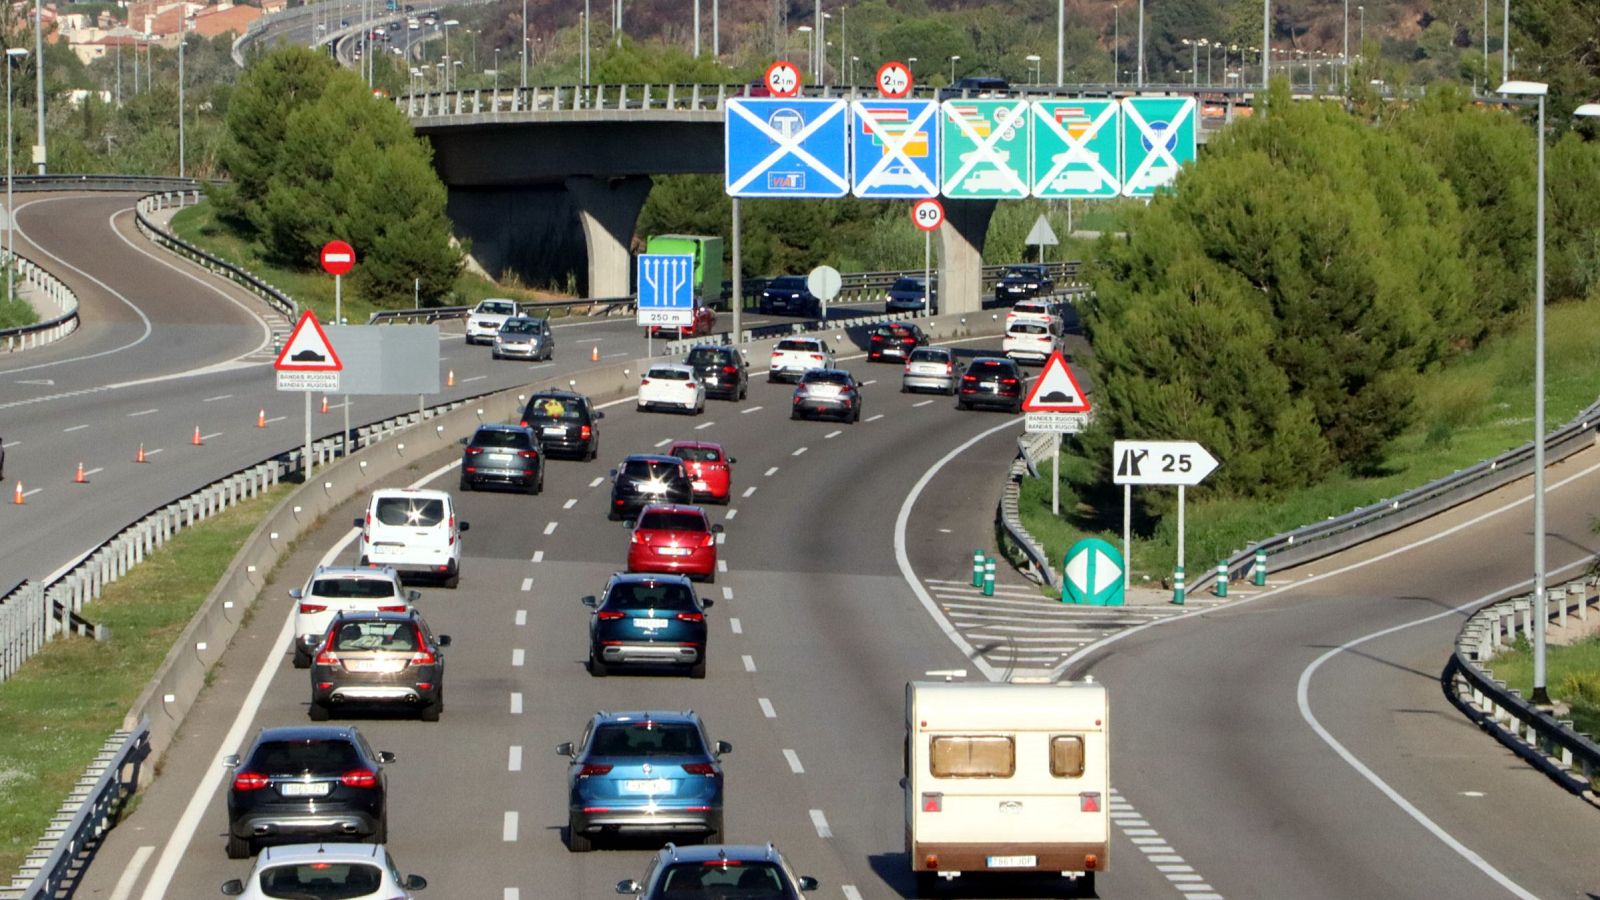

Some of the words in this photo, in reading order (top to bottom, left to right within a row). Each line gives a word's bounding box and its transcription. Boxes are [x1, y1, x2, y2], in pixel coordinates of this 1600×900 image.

[919, 209, 937, 220] 90
[650, 313, 669, 321] 250
[1161, 453, 1192, 473] 25
